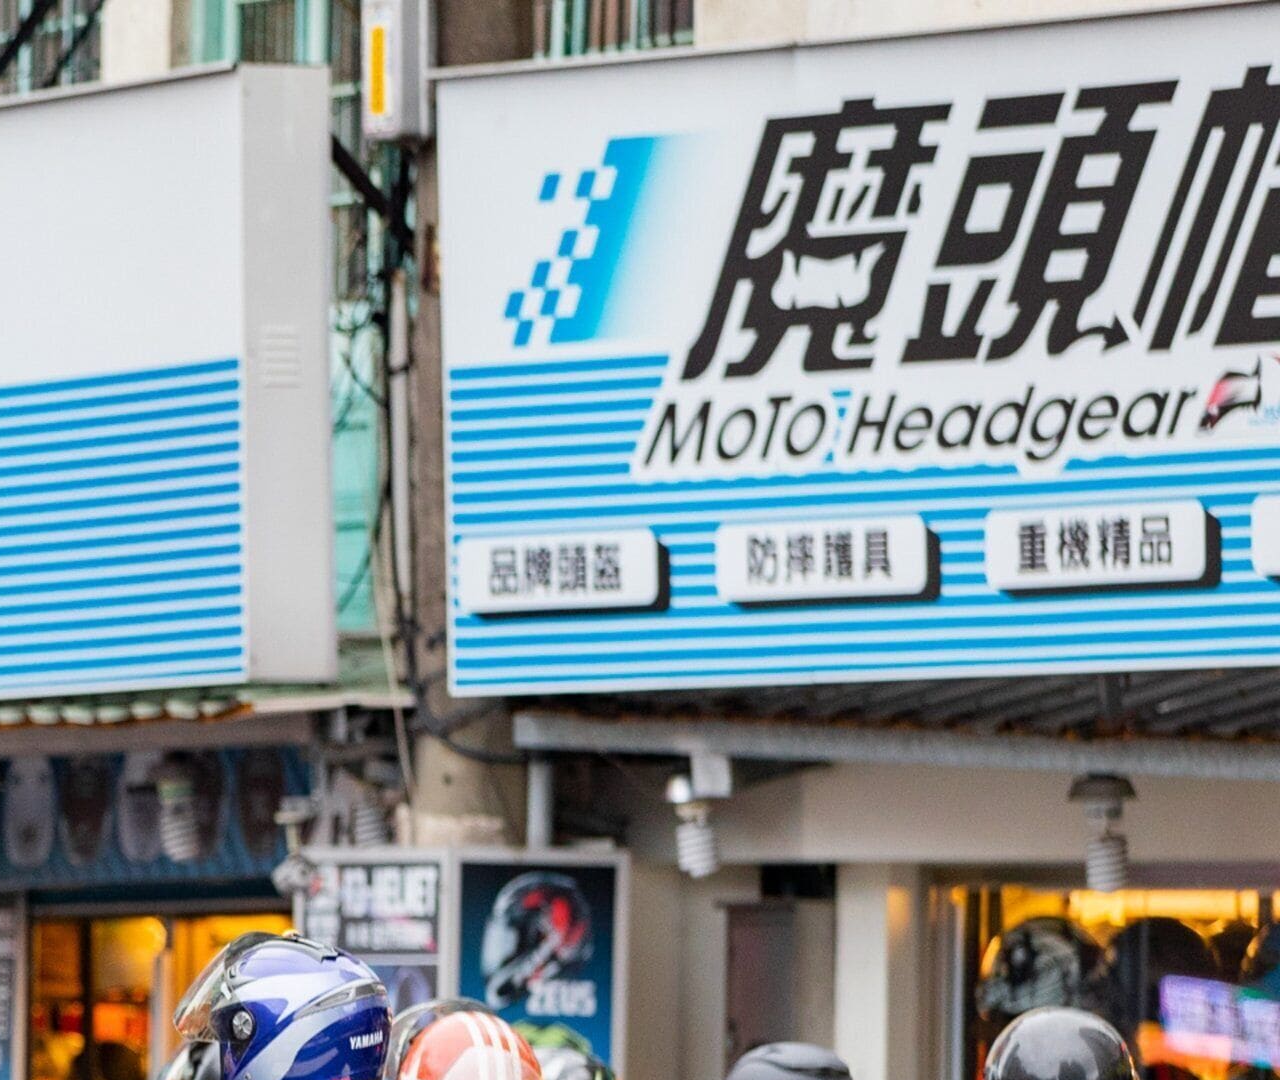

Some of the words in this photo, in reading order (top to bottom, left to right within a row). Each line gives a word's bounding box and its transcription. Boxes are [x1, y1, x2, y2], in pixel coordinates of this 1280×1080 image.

[847, 386, 1200, 463] Headgear
[488, 545, 624, 598] 品牌頭盔
[746, 529, 894, 583] 防摔護具
[1016, 516, 1174, 575] 重機精品
[526, 981, 597, 1017] ZEUS
[349, 1030, 383, 1050] YAMAHA
